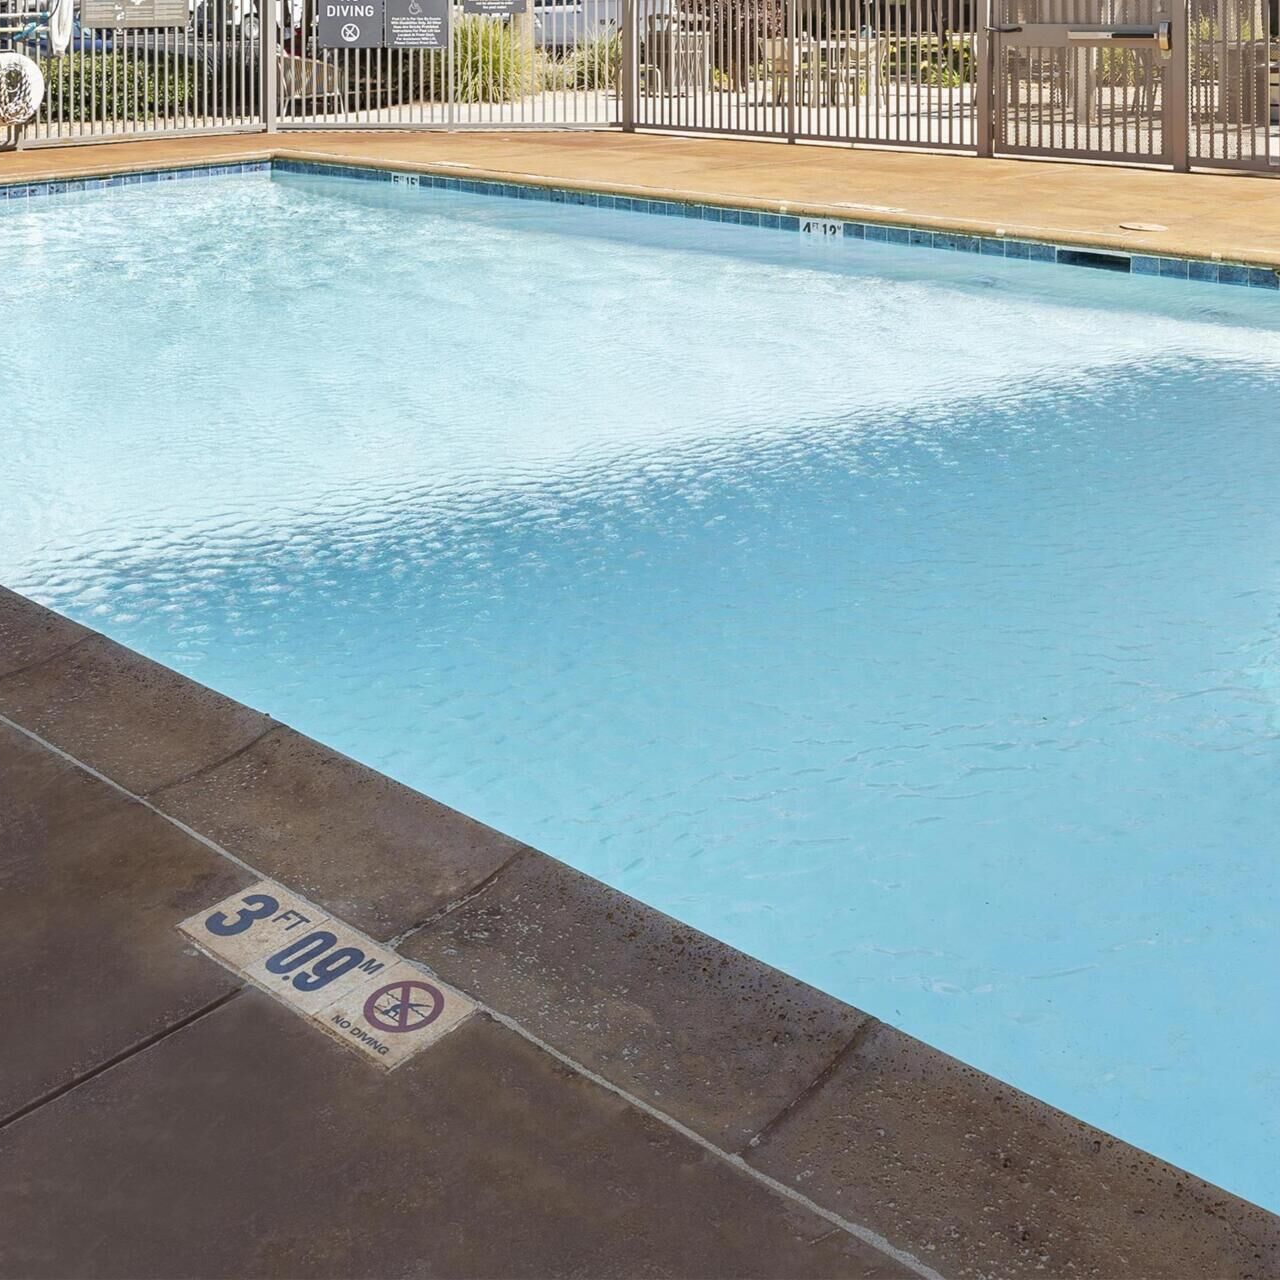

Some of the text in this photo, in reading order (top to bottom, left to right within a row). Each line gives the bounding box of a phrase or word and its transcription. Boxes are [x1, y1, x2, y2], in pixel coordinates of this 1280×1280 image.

[326, 5, 375, 17] DIVING
[331, 1015, 390, 1056] NO DIVING
